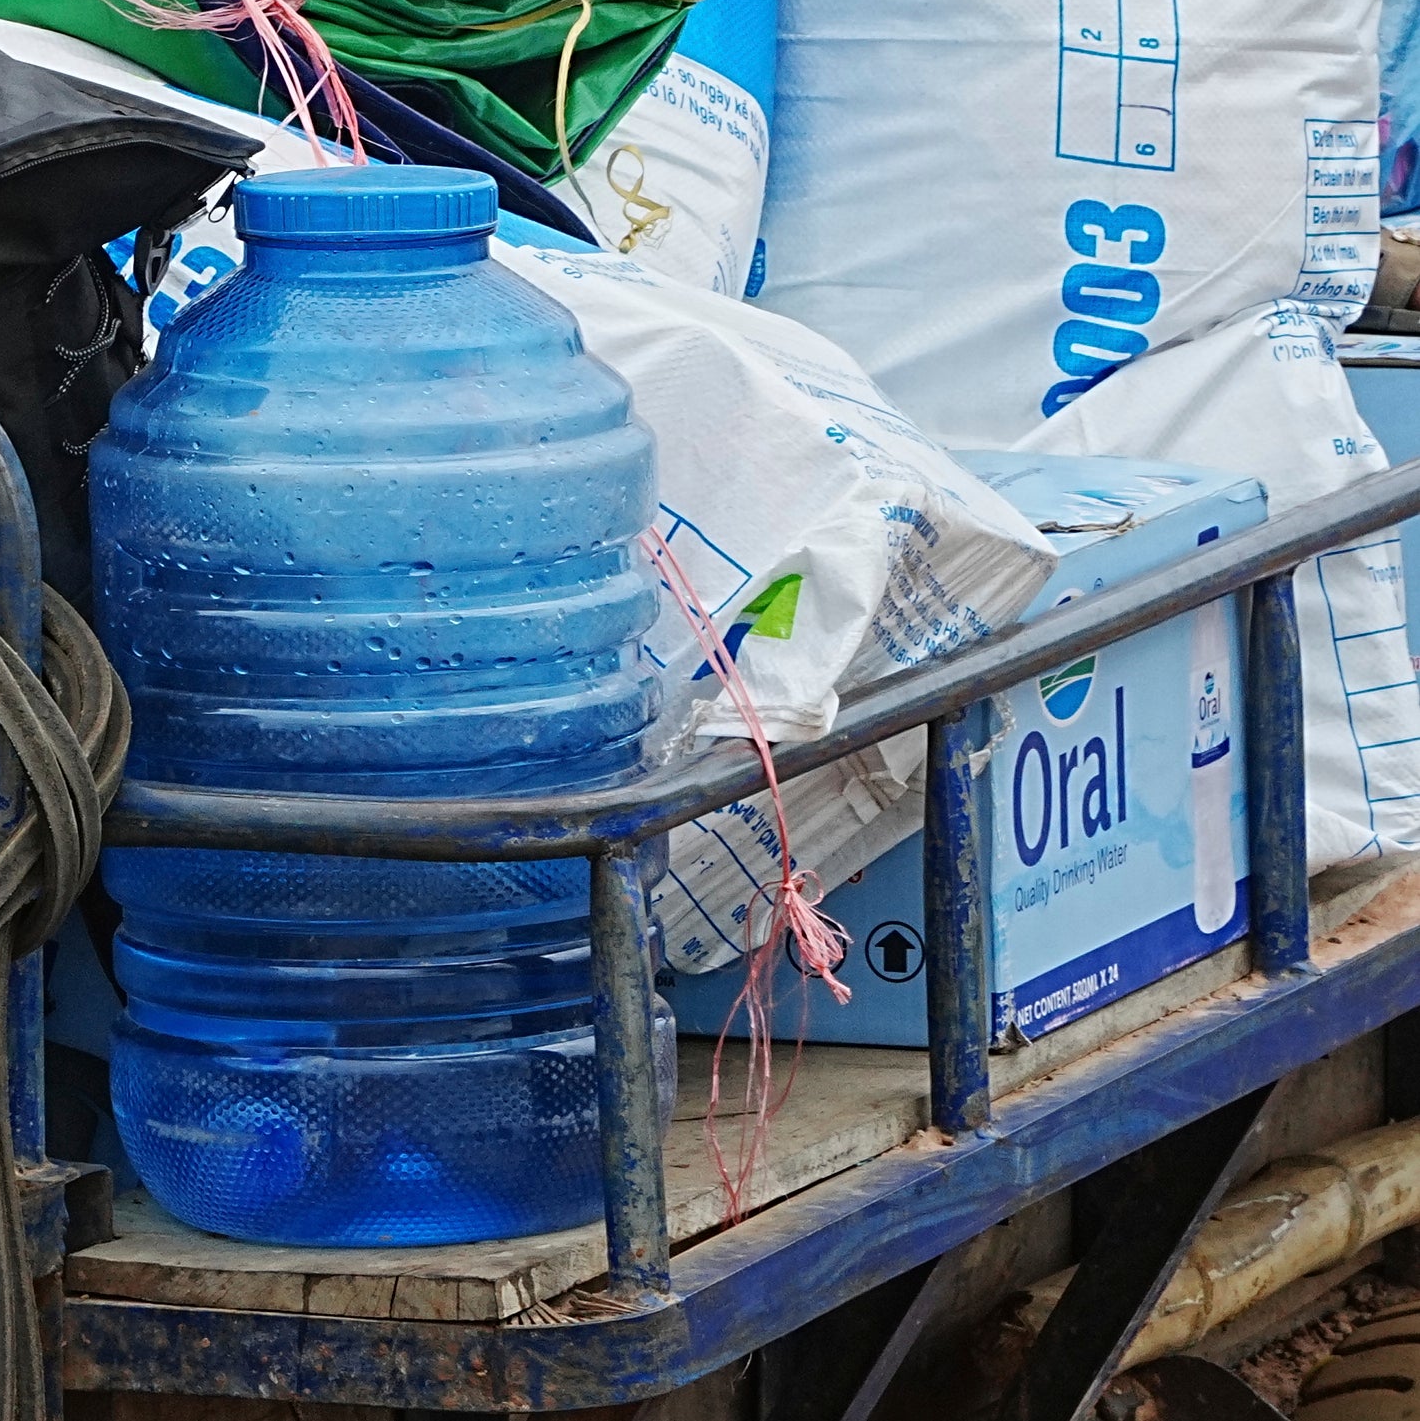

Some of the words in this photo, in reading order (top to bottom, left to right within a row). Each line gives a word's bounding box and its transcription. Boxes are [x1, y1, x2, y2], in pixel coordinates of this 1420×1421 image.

[1081, 27, 1102, 42] 2
[1139, 37, 1160, 50] 8
[677, 68, 697, 89] 90
[699, 79, 732, 112] ngày
[688, 96, 723, 133] Ngày
[1135, 142, 1157, 158] 6
[1198, 688, 1222, 722] Oral
[1012, 685, 1128, 868] Oral
[1014, 879, 1050, 913] Quality
[1053, 855, 1096, 895] Drinking
[1097, 843, 1128, 874] Water
[1016, 1004, 1034, 1028] NET
[1033, 986, 1072, 1021] CONTENT
[1108, 962, 1120, 984] 24
